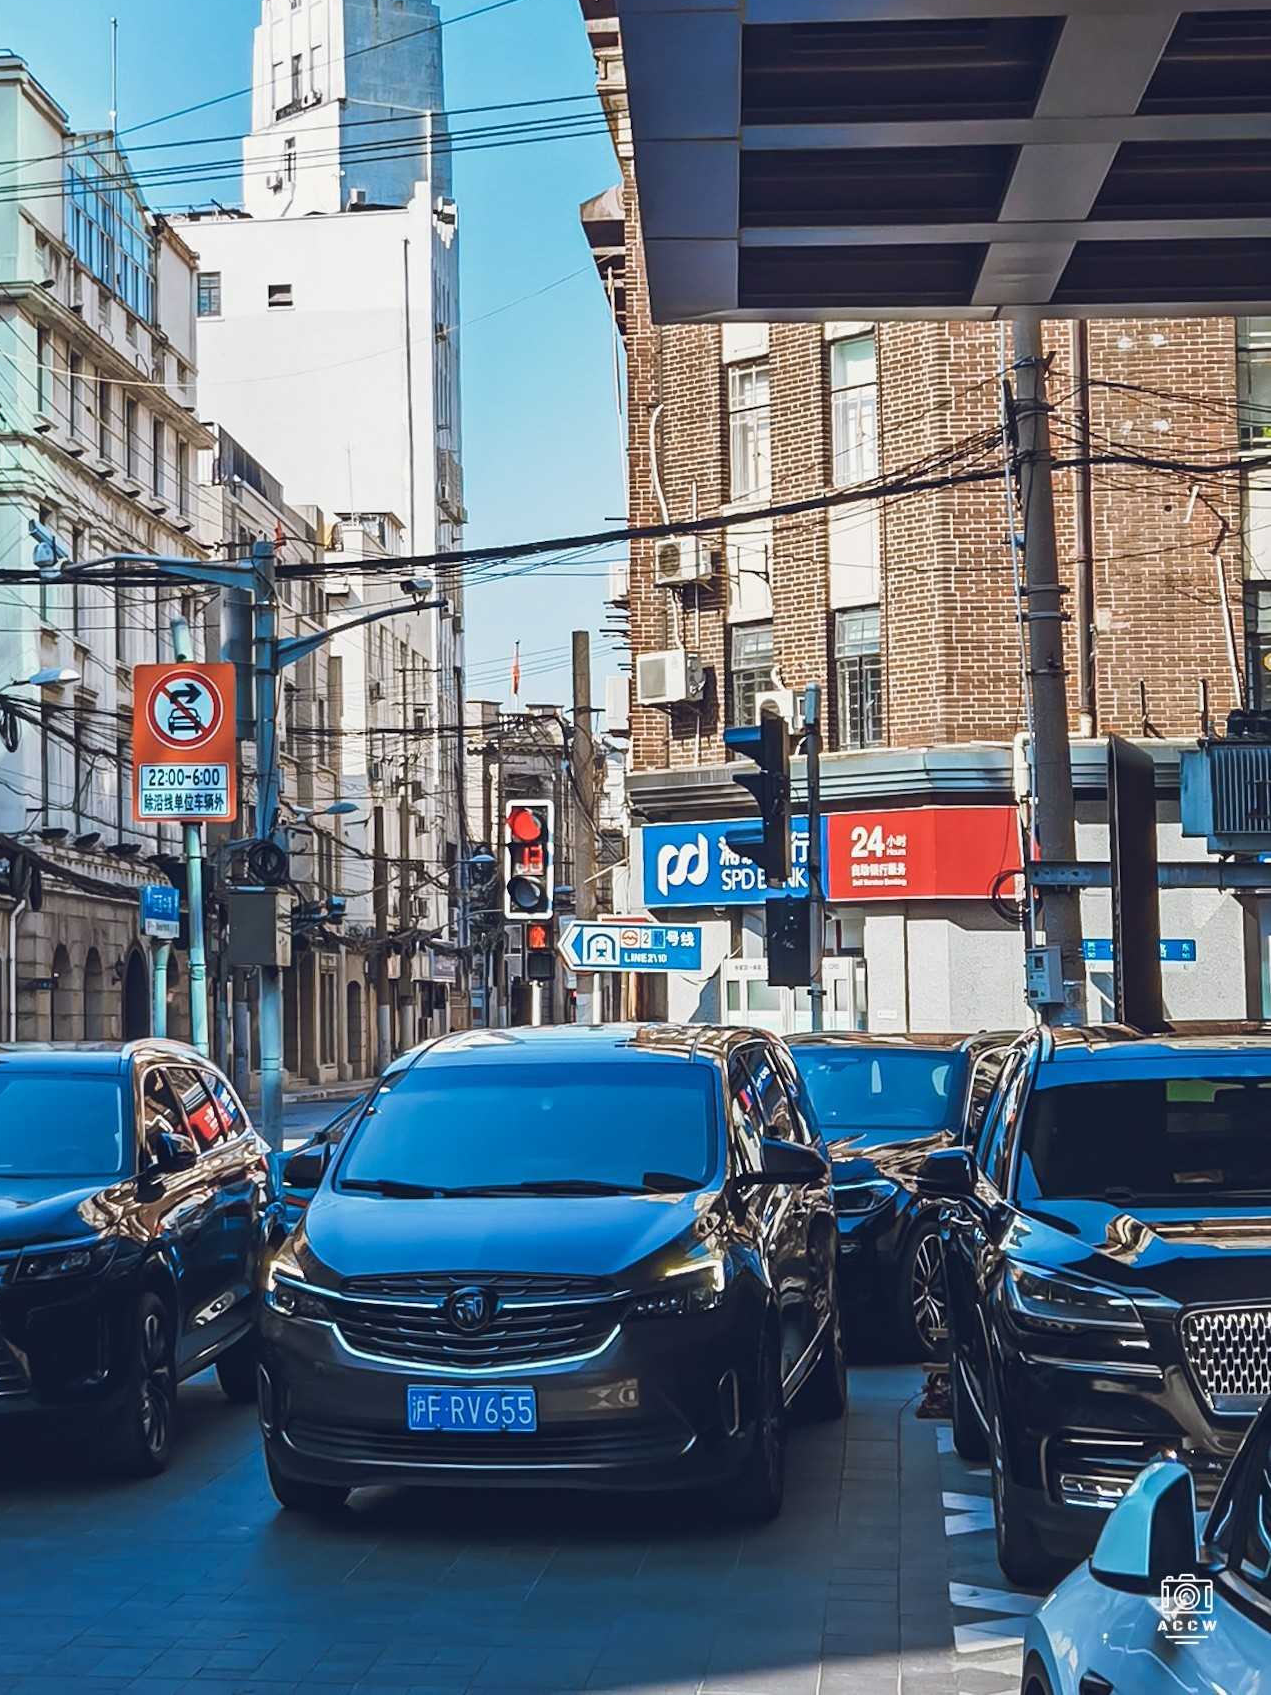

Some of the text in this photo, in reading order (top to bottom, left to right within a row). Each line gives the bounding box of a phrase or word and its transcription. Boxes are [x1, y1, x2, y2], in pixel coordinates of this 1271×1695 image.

[149, 768, 220, 785] 22:00-6:00
[144, 793, 224, 811] 除沿线单位车辆外
[851, 825, 885, 857] 24
[721, 868, 755, 891] SPD
[665, 929, 696, 947] 号线
